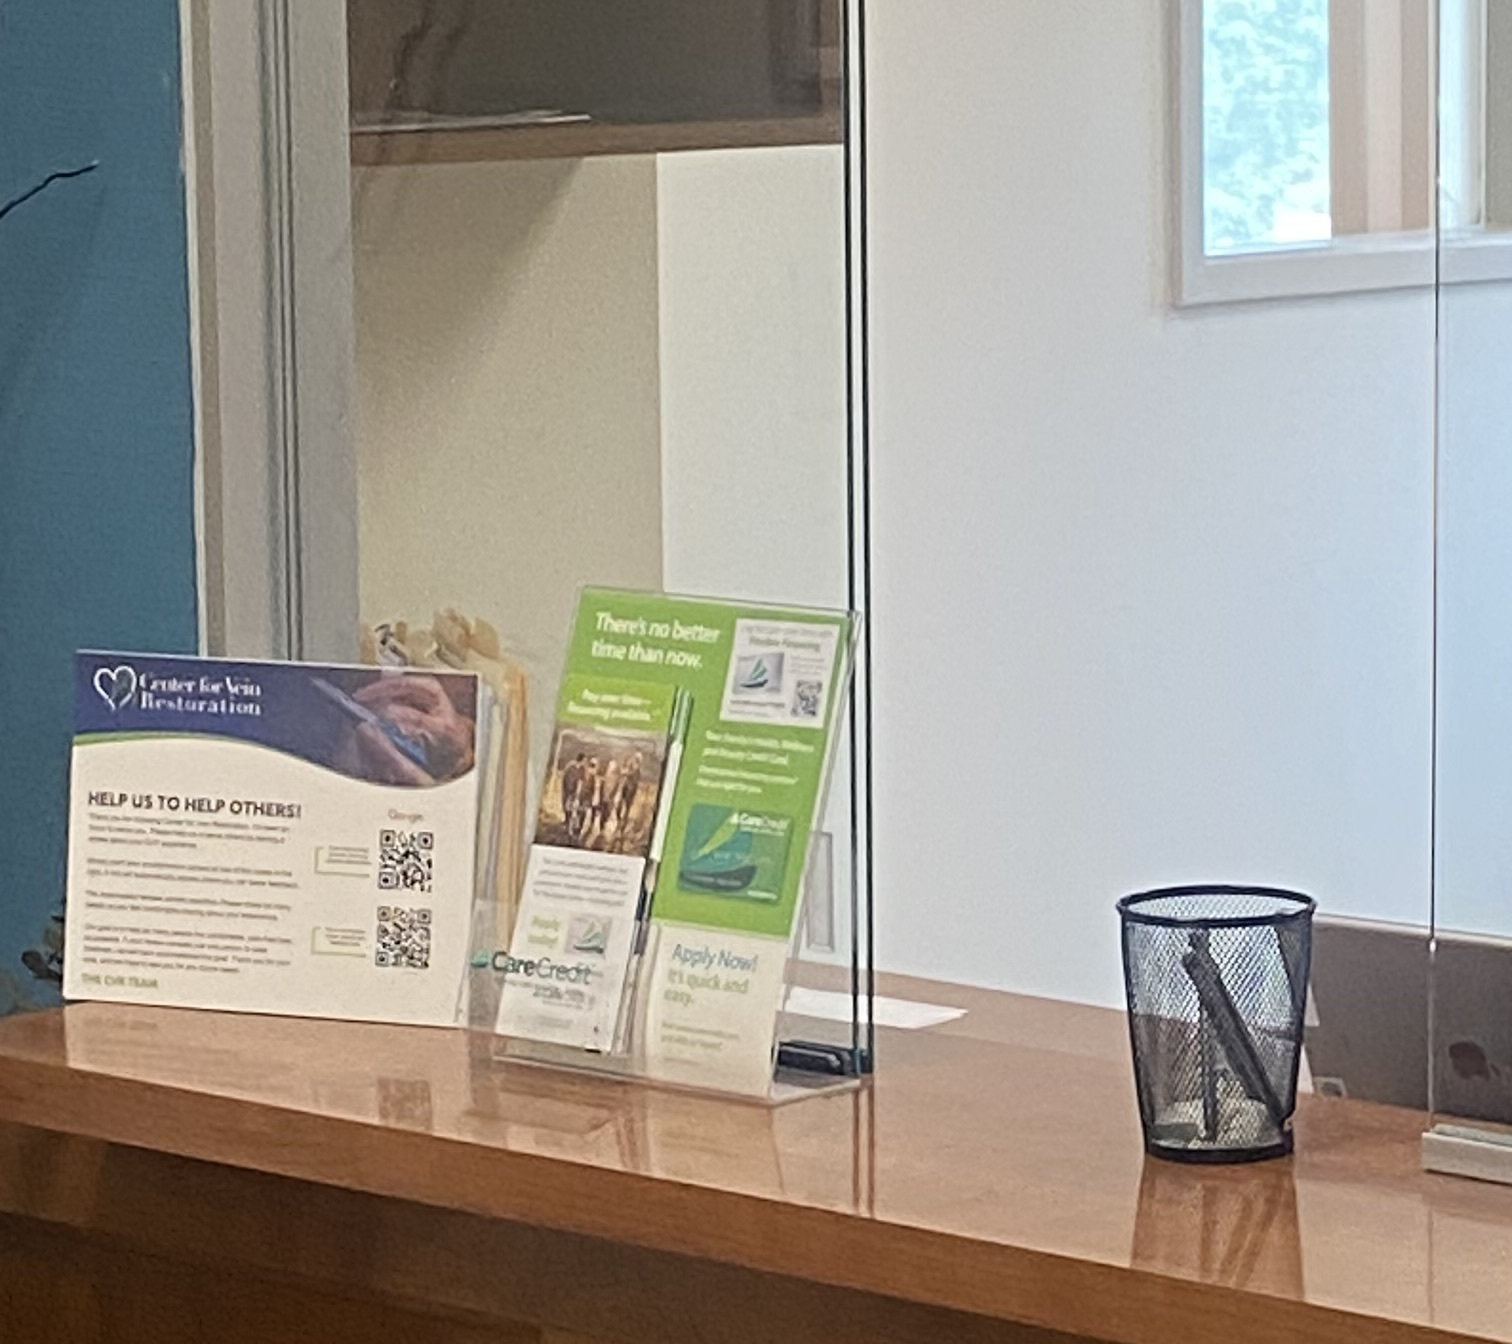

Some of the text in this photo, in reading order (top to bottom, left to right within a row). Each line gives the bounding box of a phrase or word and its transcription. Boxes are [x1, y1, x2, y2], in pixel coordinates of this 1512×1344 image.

[595, 612, 647, 636] There's
[649, 622, 670, 639] no
[672, 619, 721, 643] better
[591, 638, 703, 671] time than now.
[139, 672, 262, 698] Center for Vein
[139, 690, 263, 716] Restoration
[88, 791, 302, 819] HELP US TO HELP OTHERS!
[492, 951, 592, 986] CareCredit
[672, 943, 759, 973] Apply Now!
[722, 978, 749, 994] and
